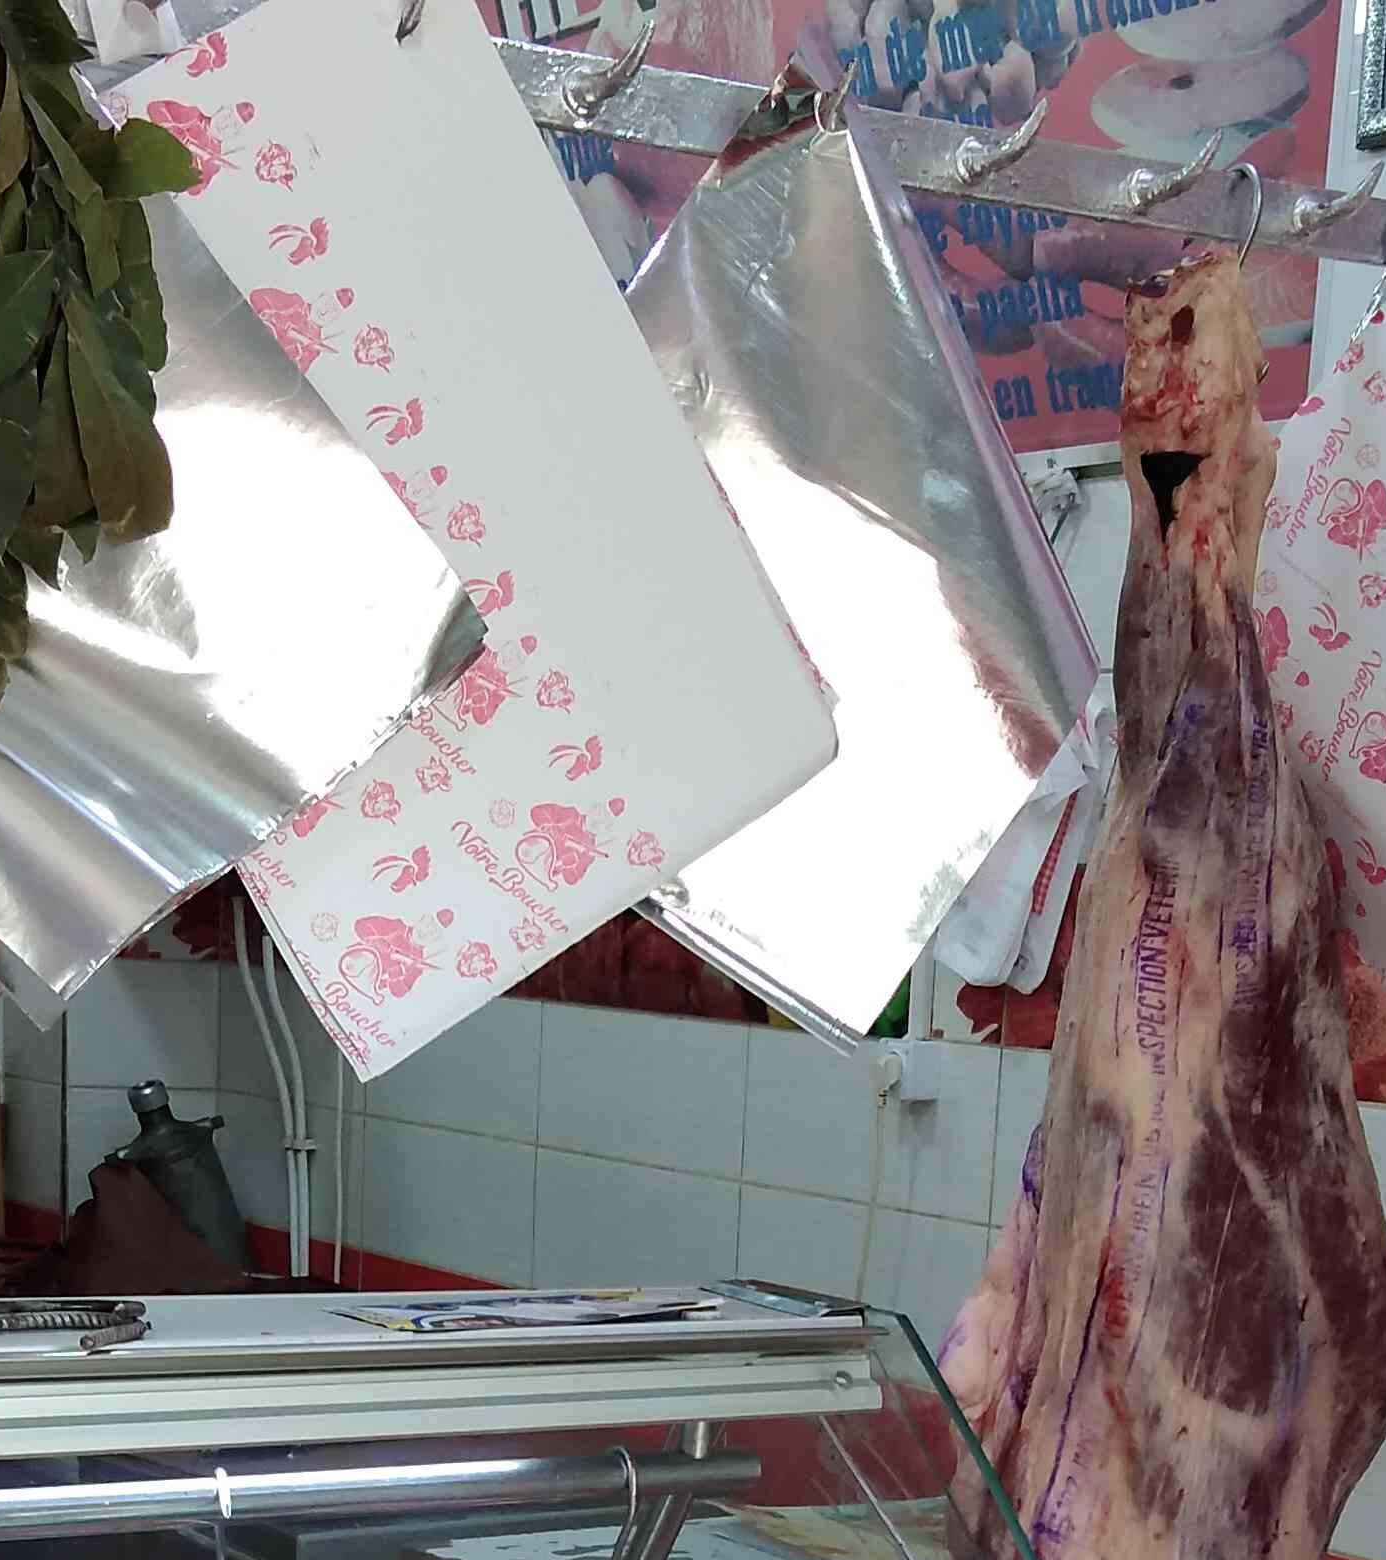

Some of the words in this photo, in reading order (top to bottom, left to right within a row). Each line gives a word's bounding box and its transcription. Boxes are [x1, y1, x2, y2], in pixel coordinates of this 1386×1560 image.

[993, 375, 1038, 421] en
[1285, 464, 1331, 548] Boucher
[1350, 649, 1384, 703] Votre
[1321, 697, 1360, 784] Boucher
[450, 820, 501, 876] Votre
[487, 866, 572, 937] Boucher
[317, 980, 397, 1050] Boucher
